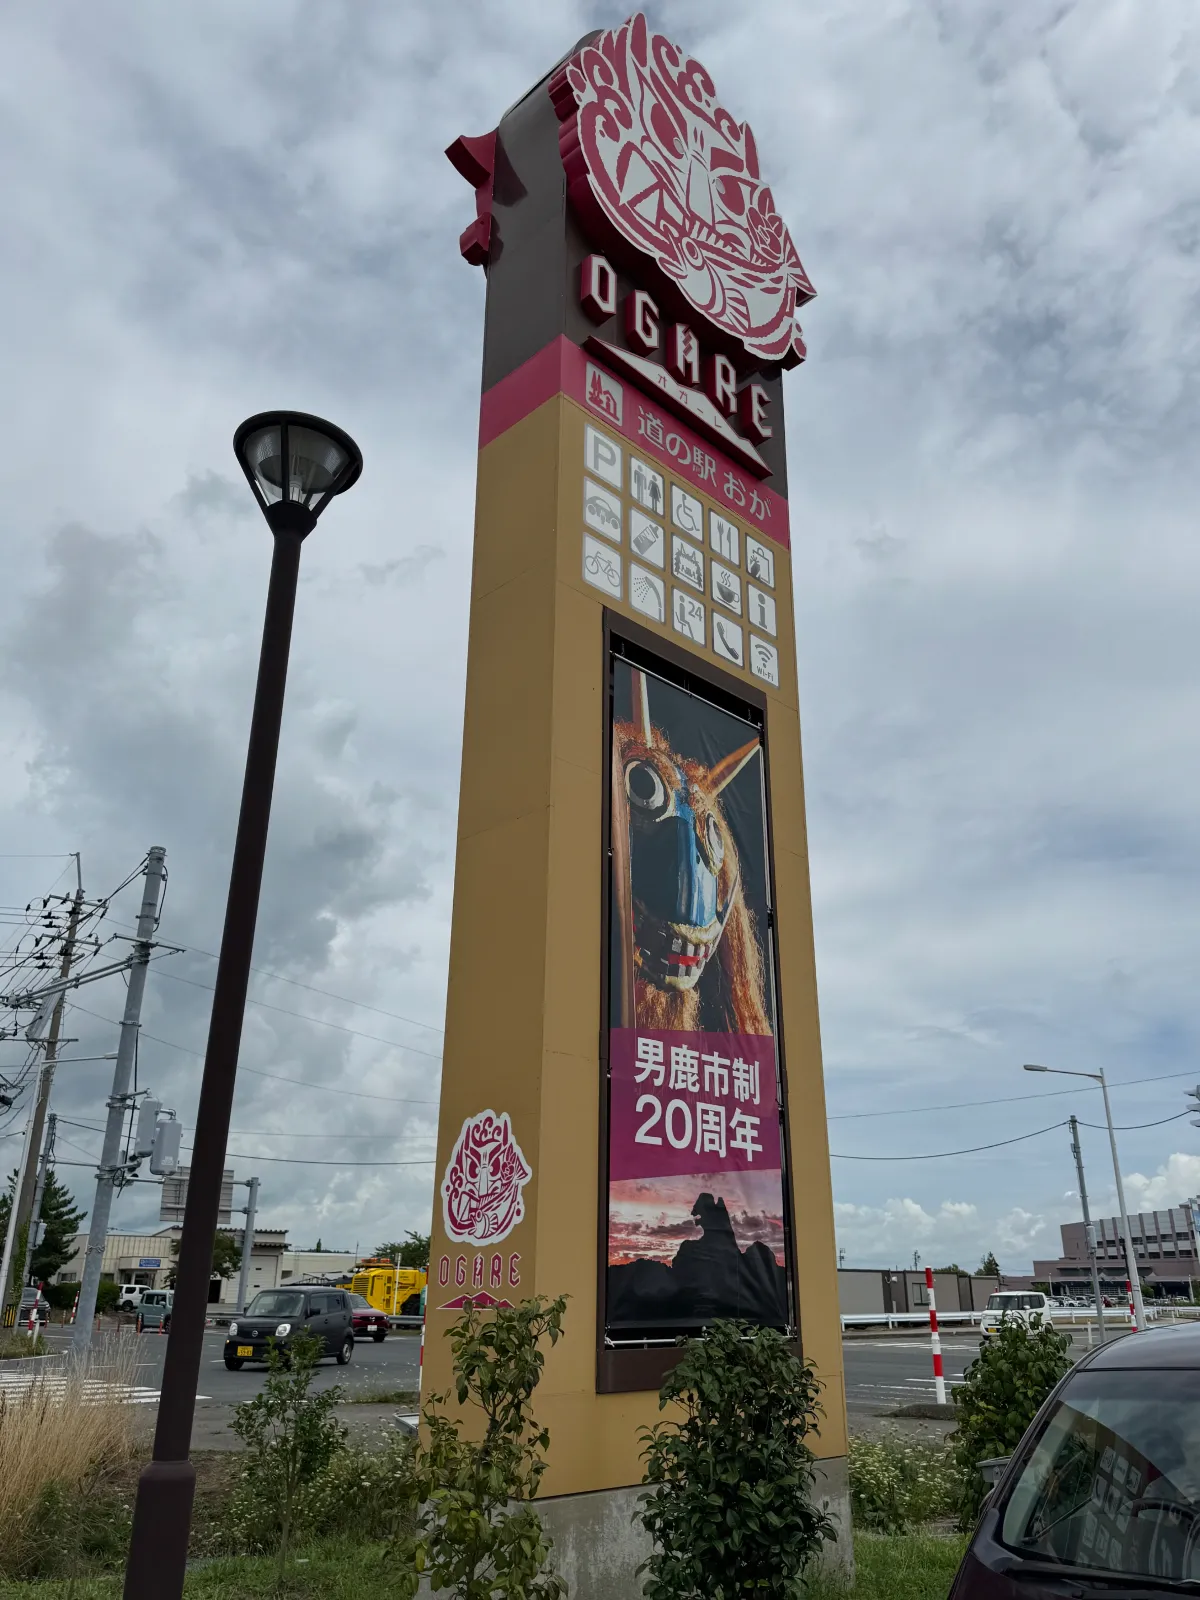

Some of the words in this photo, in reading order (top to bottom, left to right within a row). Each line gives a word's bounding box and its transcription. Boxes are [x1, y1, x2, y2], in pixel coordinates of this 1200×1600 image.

[583, 253, 774, 438] OGARE
[657, 373, 723, 429] オガーレ
[593, 435, 617, 475] P
[637, 405, 718, 488] 道の駅
[723, 471, 772, 521] おが
[688, 600, 703, 622] 24
[634, 1036, 761, 1105] 男鹿市制
[634, 1093, 764, 1162] 20周年
[438, 1252, 522, 1289] OGARE
